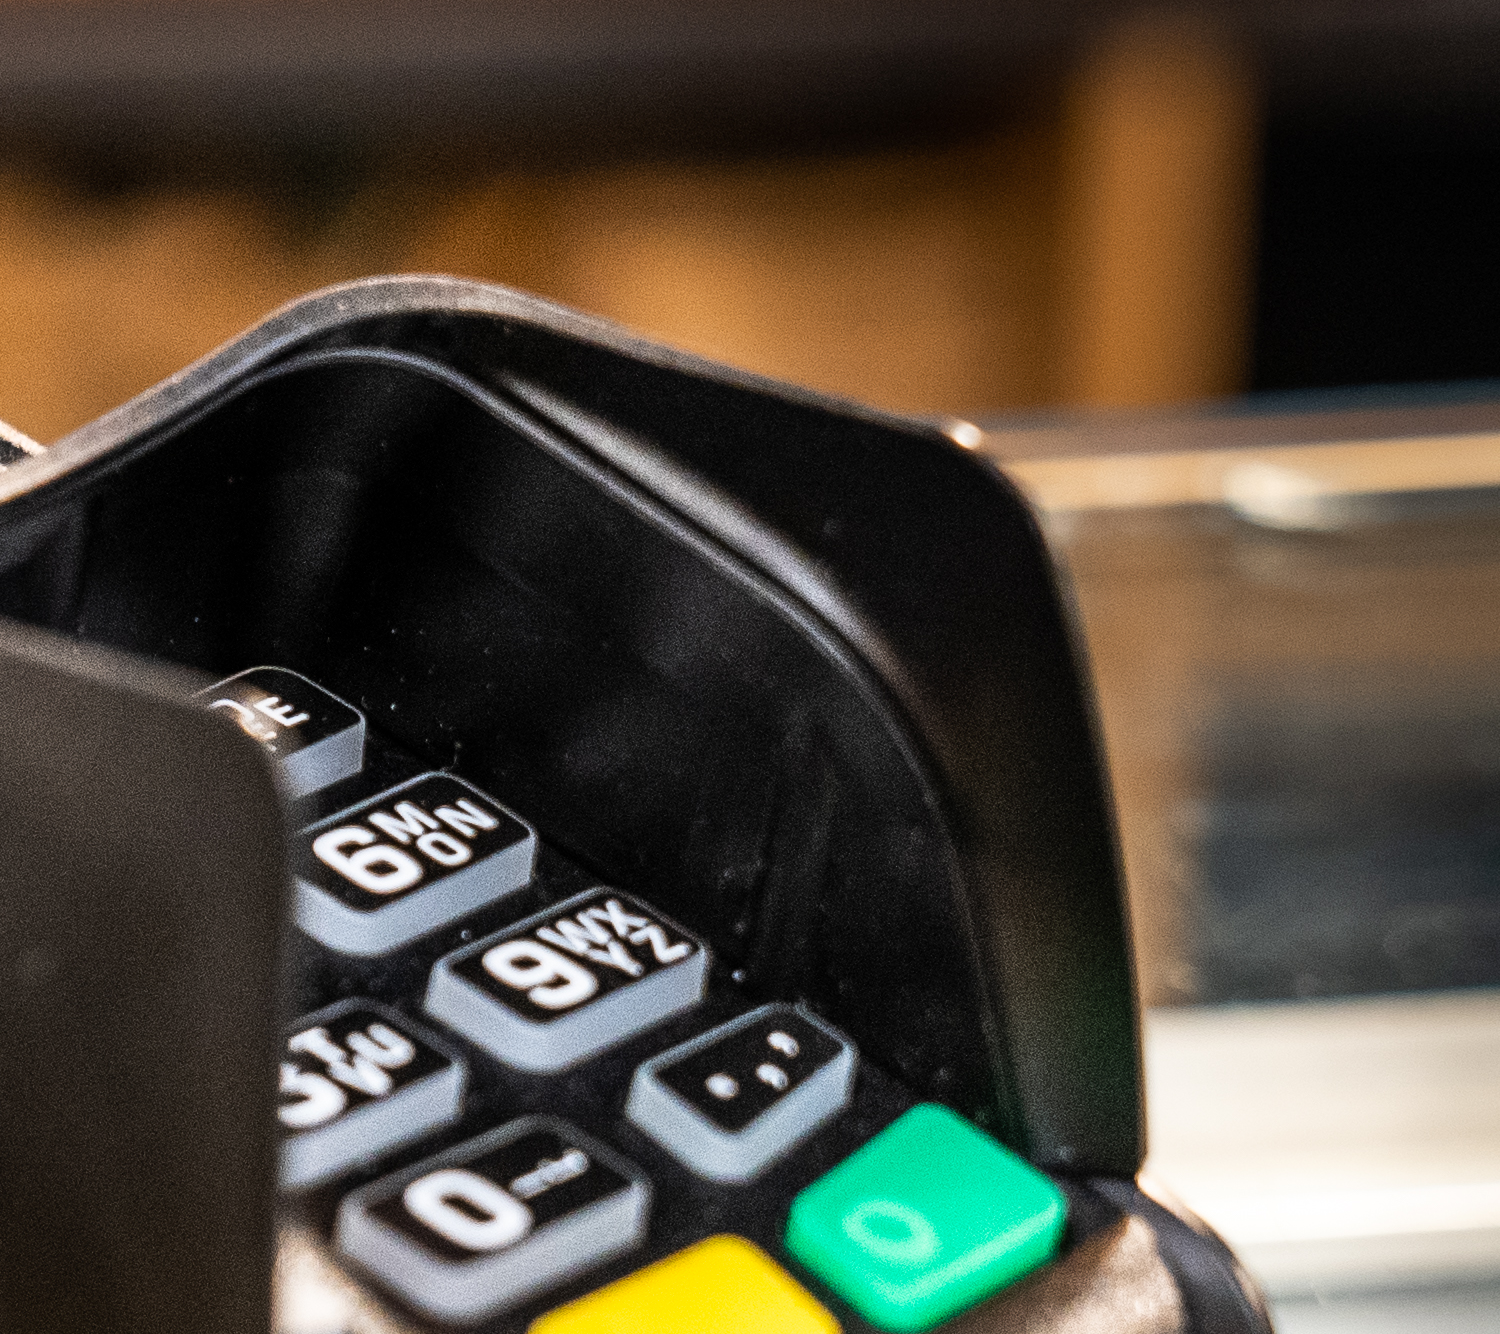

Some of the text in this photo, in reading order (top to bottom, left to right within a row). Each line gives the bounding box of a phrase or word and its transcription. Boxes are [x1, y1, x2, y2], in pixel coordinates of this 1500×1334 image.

[313, 825, 423, 894] 6
[482, 940, 599, 1009] 9
[403, 1169, 533, 1250] 0
